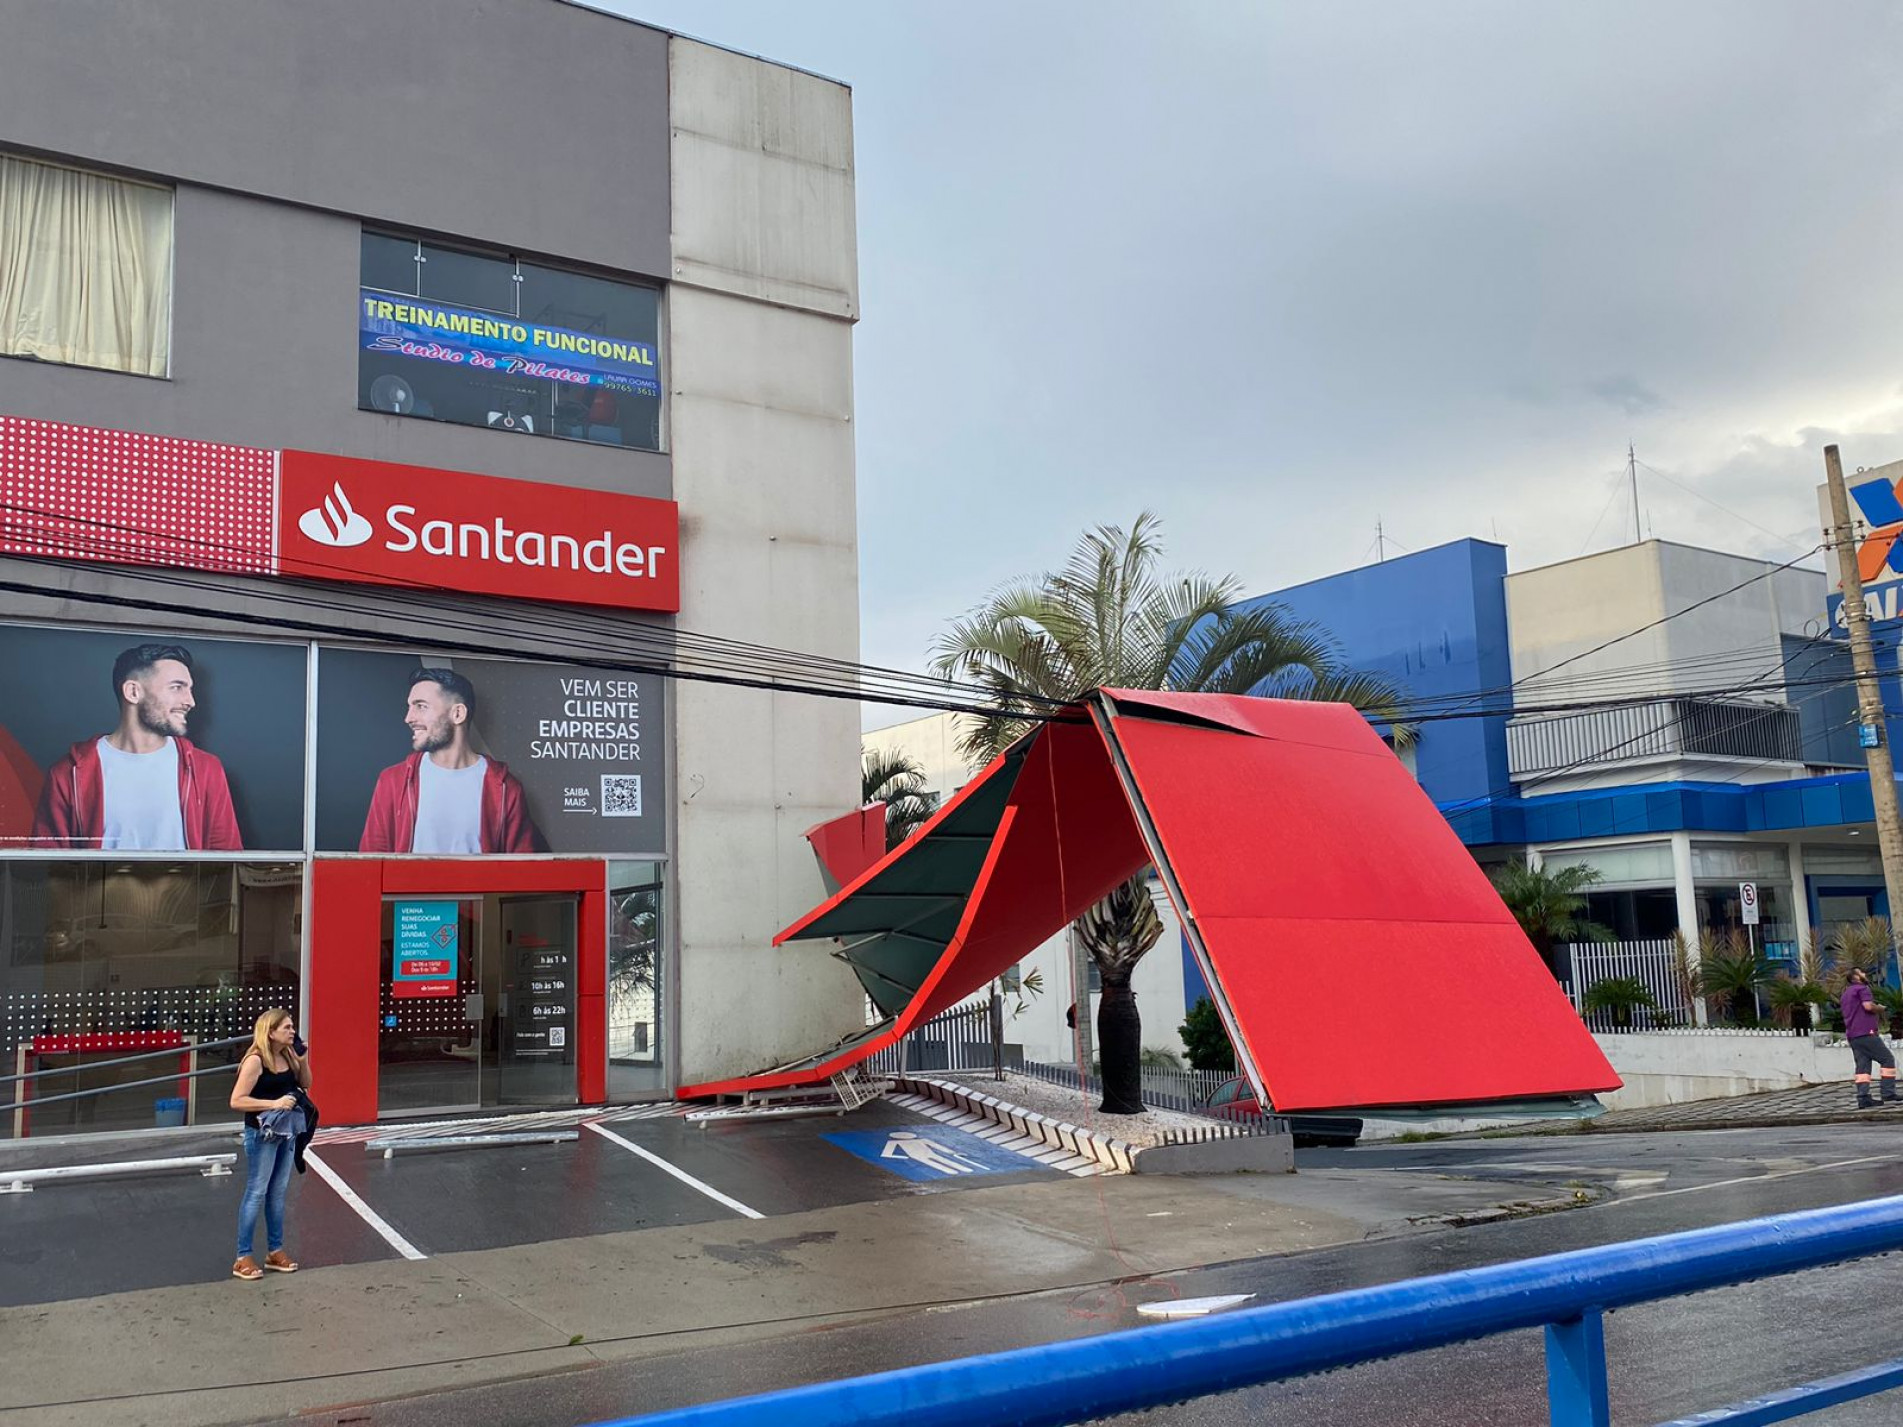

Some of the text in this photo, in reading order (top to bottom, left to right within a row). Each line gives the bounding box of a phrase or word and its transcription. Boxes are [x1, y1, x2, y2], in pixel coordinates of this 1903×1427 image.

[364, 298, 653, 366] TREINAMENTO FUNCIONAL
[366, 335, 591, 385] Studio de Pilates
[385, 504, 666, 578] Santander
[560, 678, 639, 699] VEM SER
[564, 700, 639, 719] CLIENTE
[539, 719, 640, 740] EMPRESAS
[530, 740, 641, 760] SANTANDER
[564, 787, 590, 797] SAIBA
[564, 798, 587, 806] MAIS
[552, 1005, 566, 1014] 22h
